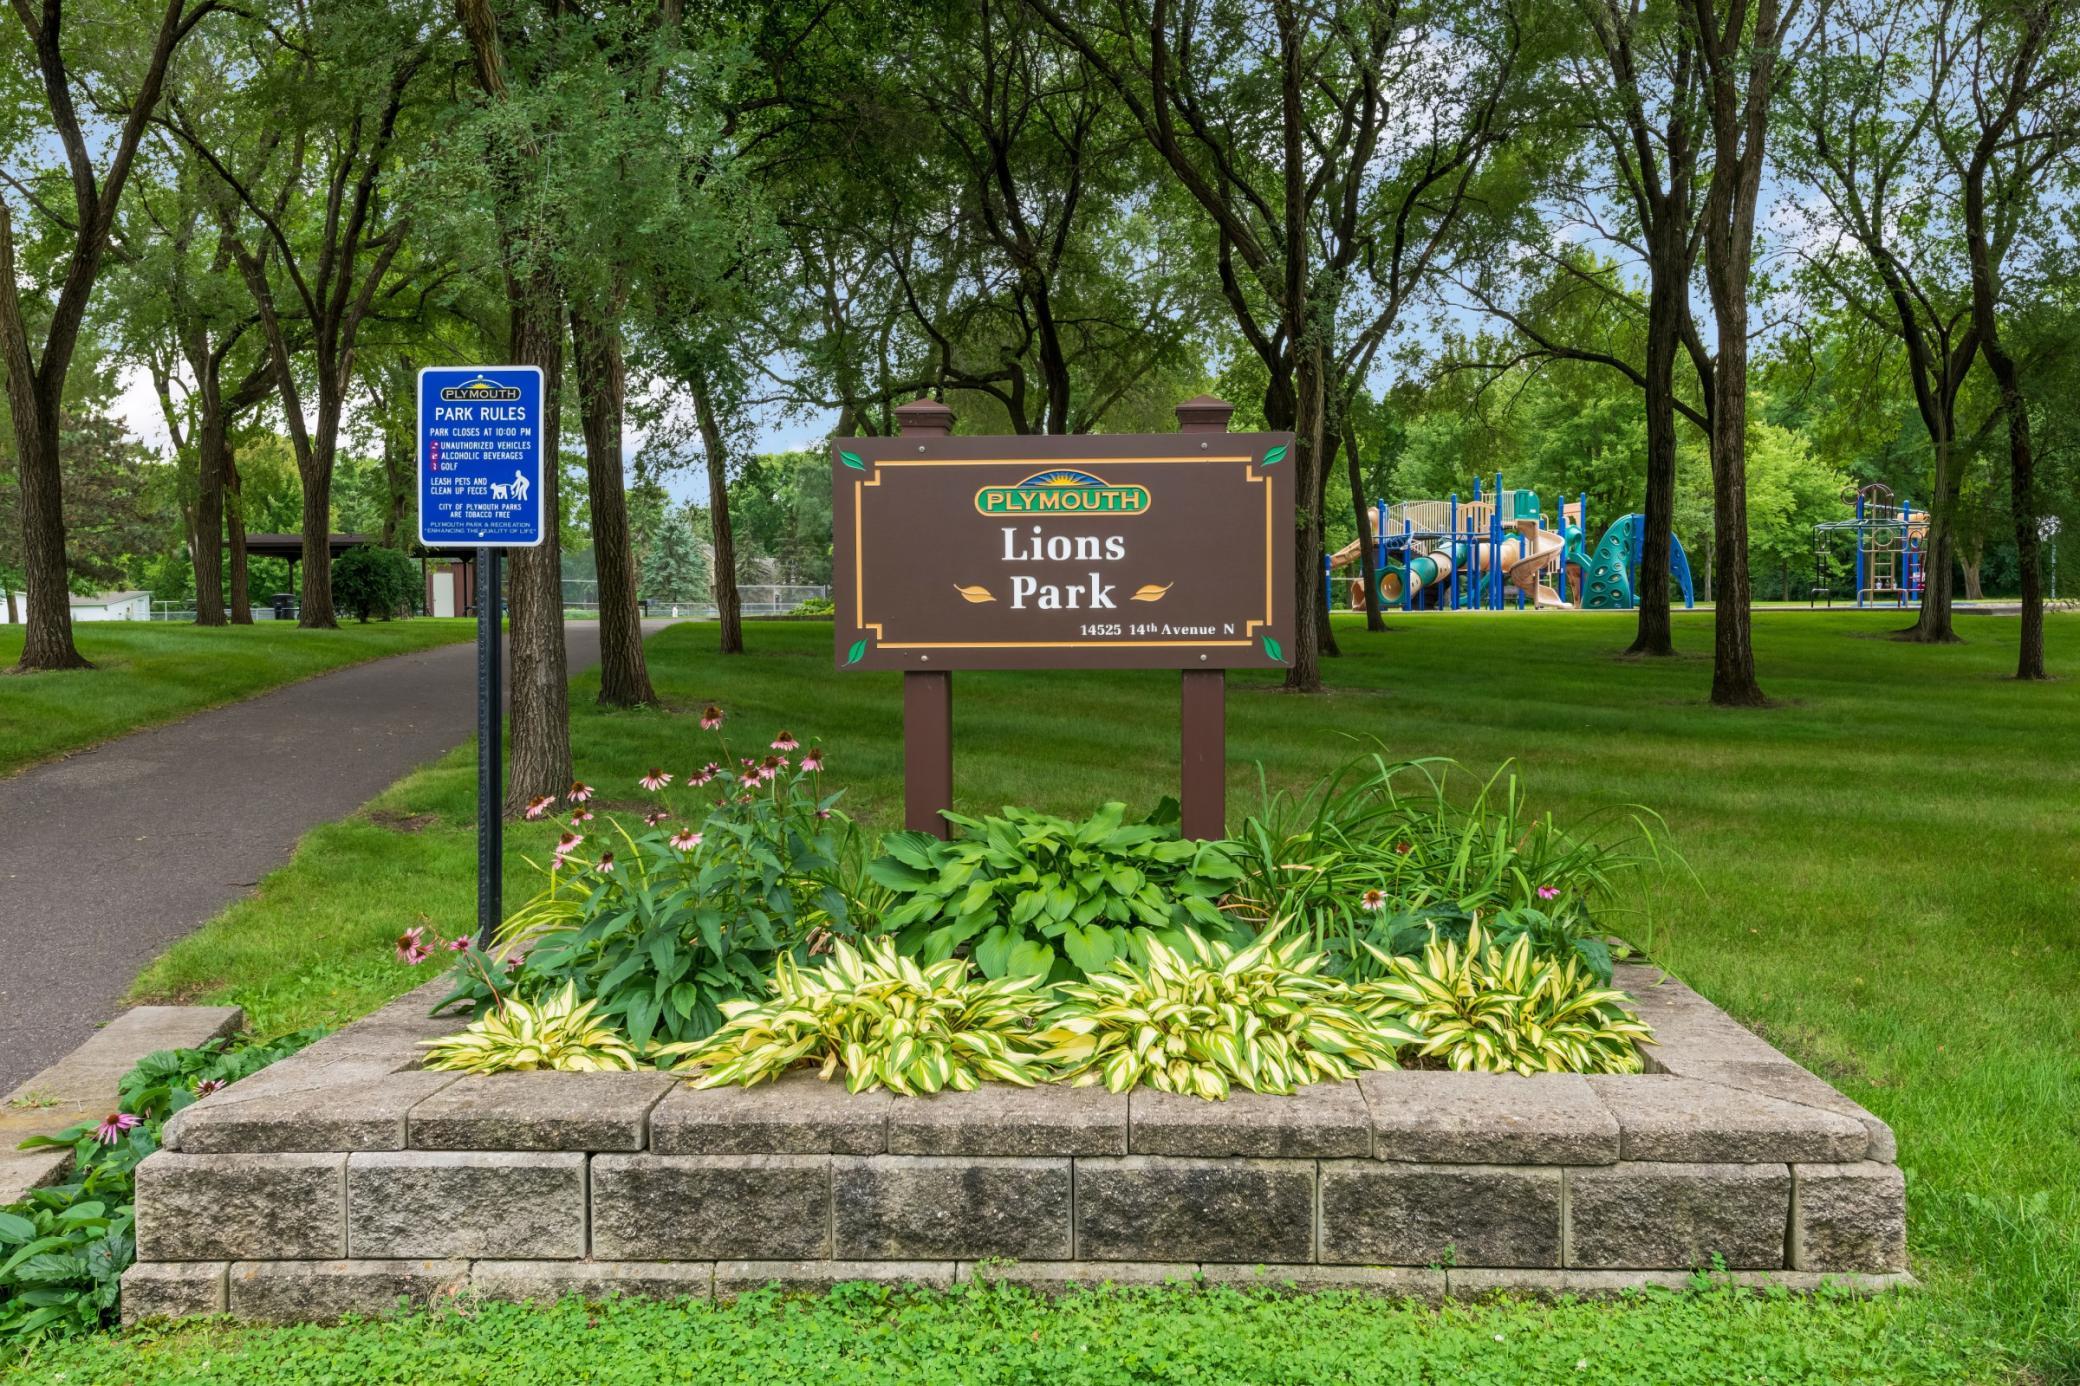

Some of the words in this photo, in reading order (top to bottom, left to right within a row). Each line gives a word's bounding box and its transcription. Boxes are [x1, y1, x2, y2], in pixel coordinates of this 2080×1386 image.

[445, 389, 516, 399] PLYMOUTH
[435, 407, 473, 421] PARK
[481, 407, 526, 421] RULES
[430, 428, 449, 436] PARK
[452, 428, 479, 436] CLOSES
[483, 428, 492, 436] AT
[495, 428, 516, 436] 10:00
[520, 428, 531, 436] PM
[440, 442, 494, 450] UNAUTHORIZED
[497, 442, 531, 450] VEHICLES
[441, 452, 480, 460] ALCOHOLIC
[483, 452, 523, 460] BEVERAGES
[441, 462, 458, 471] GOLF
[430, 478, 451, 486] LEASH
[455, 478, 471, 486] PETS
[473, 478, 487, 486] AND
[430, 487, 452, 495] CLEAN
[455, 487, 465, 495] UP
[467, 487, 487, 495] FECES
[986, 491, 1141, 512] PLYMOUTH
[1001, 525, 1126, 562] Lions
[1010, 572, 1117, 611] Park
[1080, 624, 1122, 636] 14525
[1128, 622, 1158, 636] 14th
[1161, 623, 1216, 636] Avenue
[1223, 624, 1235, 636] N
